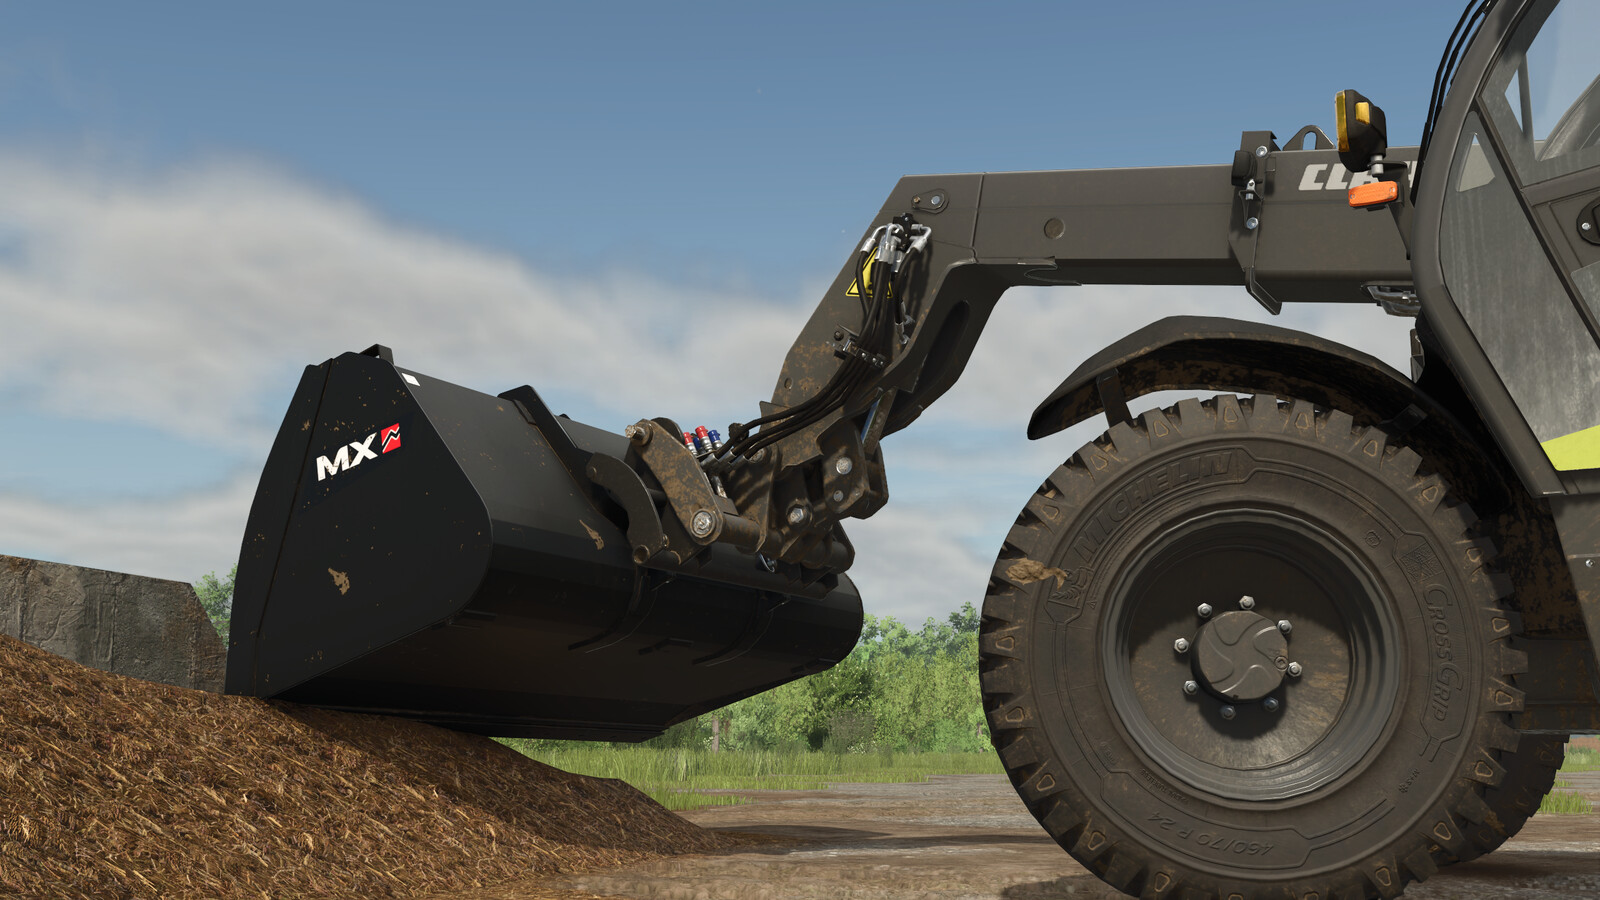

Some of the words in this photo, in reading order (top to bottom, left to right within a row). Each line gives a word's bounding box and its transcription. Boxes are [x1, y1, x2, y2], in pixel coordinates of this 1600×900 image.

[316, 432, 378, 481] MX
[1074, 452, 1232, 562] MICHELIN
[1147, 812, 1176, 830] 24
[1177, 827, 1193, 839] R
[1198, 831, 1274, 855] 460/70
